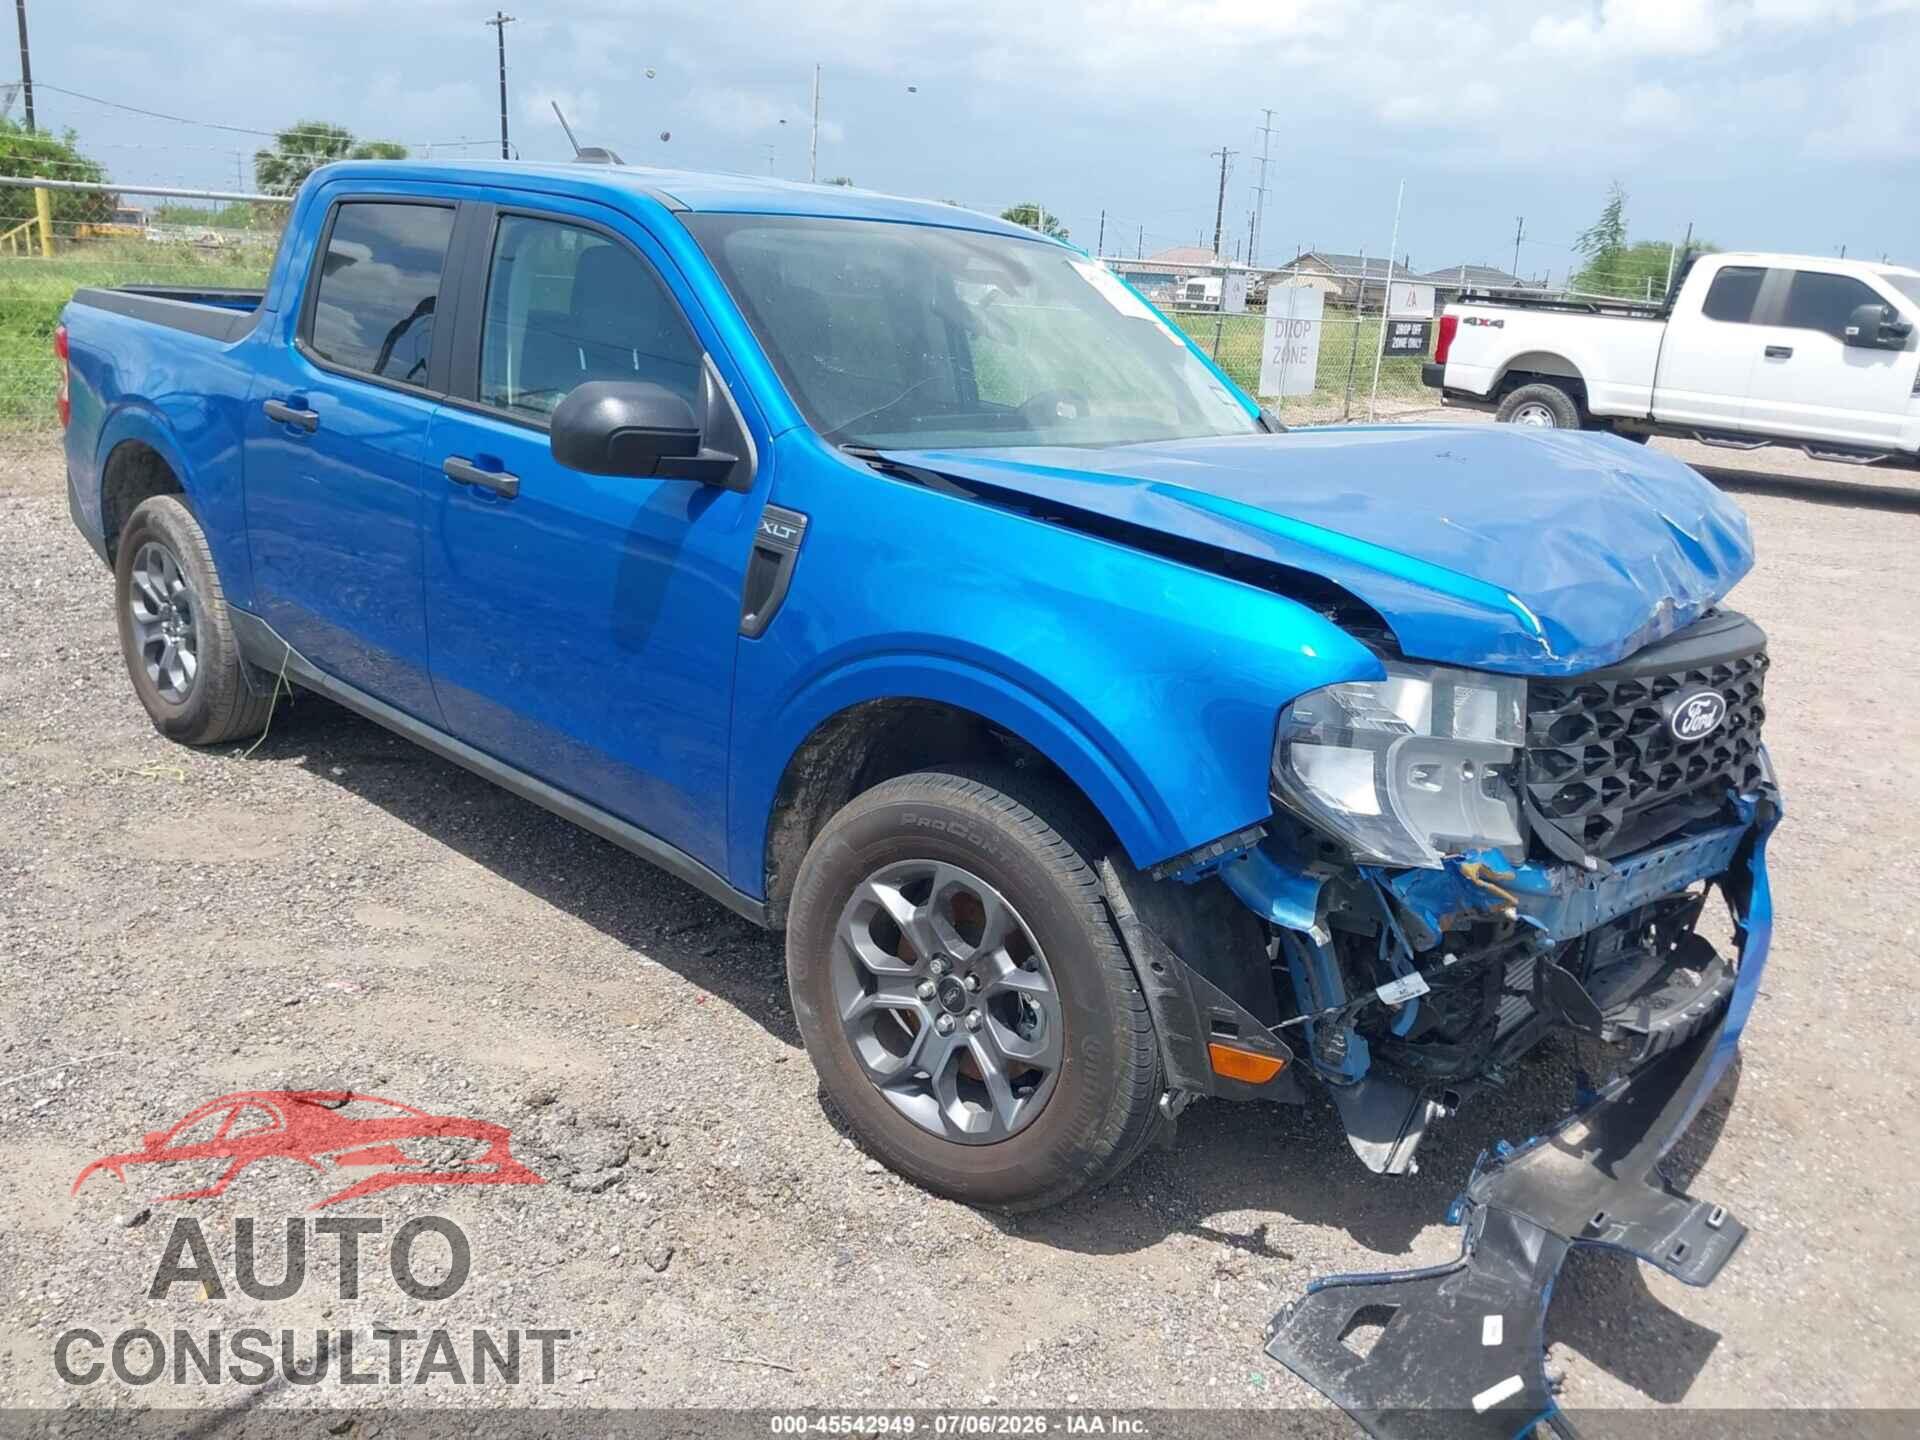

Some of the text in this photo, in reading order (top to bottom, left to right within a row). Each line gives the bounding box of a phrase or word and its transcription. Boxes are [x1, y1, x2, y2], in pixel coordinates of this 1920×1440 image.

[1275, 320, 1311, 338] DROP
[1273, 346, 1308, 364] ZONE
[757, 520, 797, 539] XLT
[1682, 699, 1718, 733] Ford
